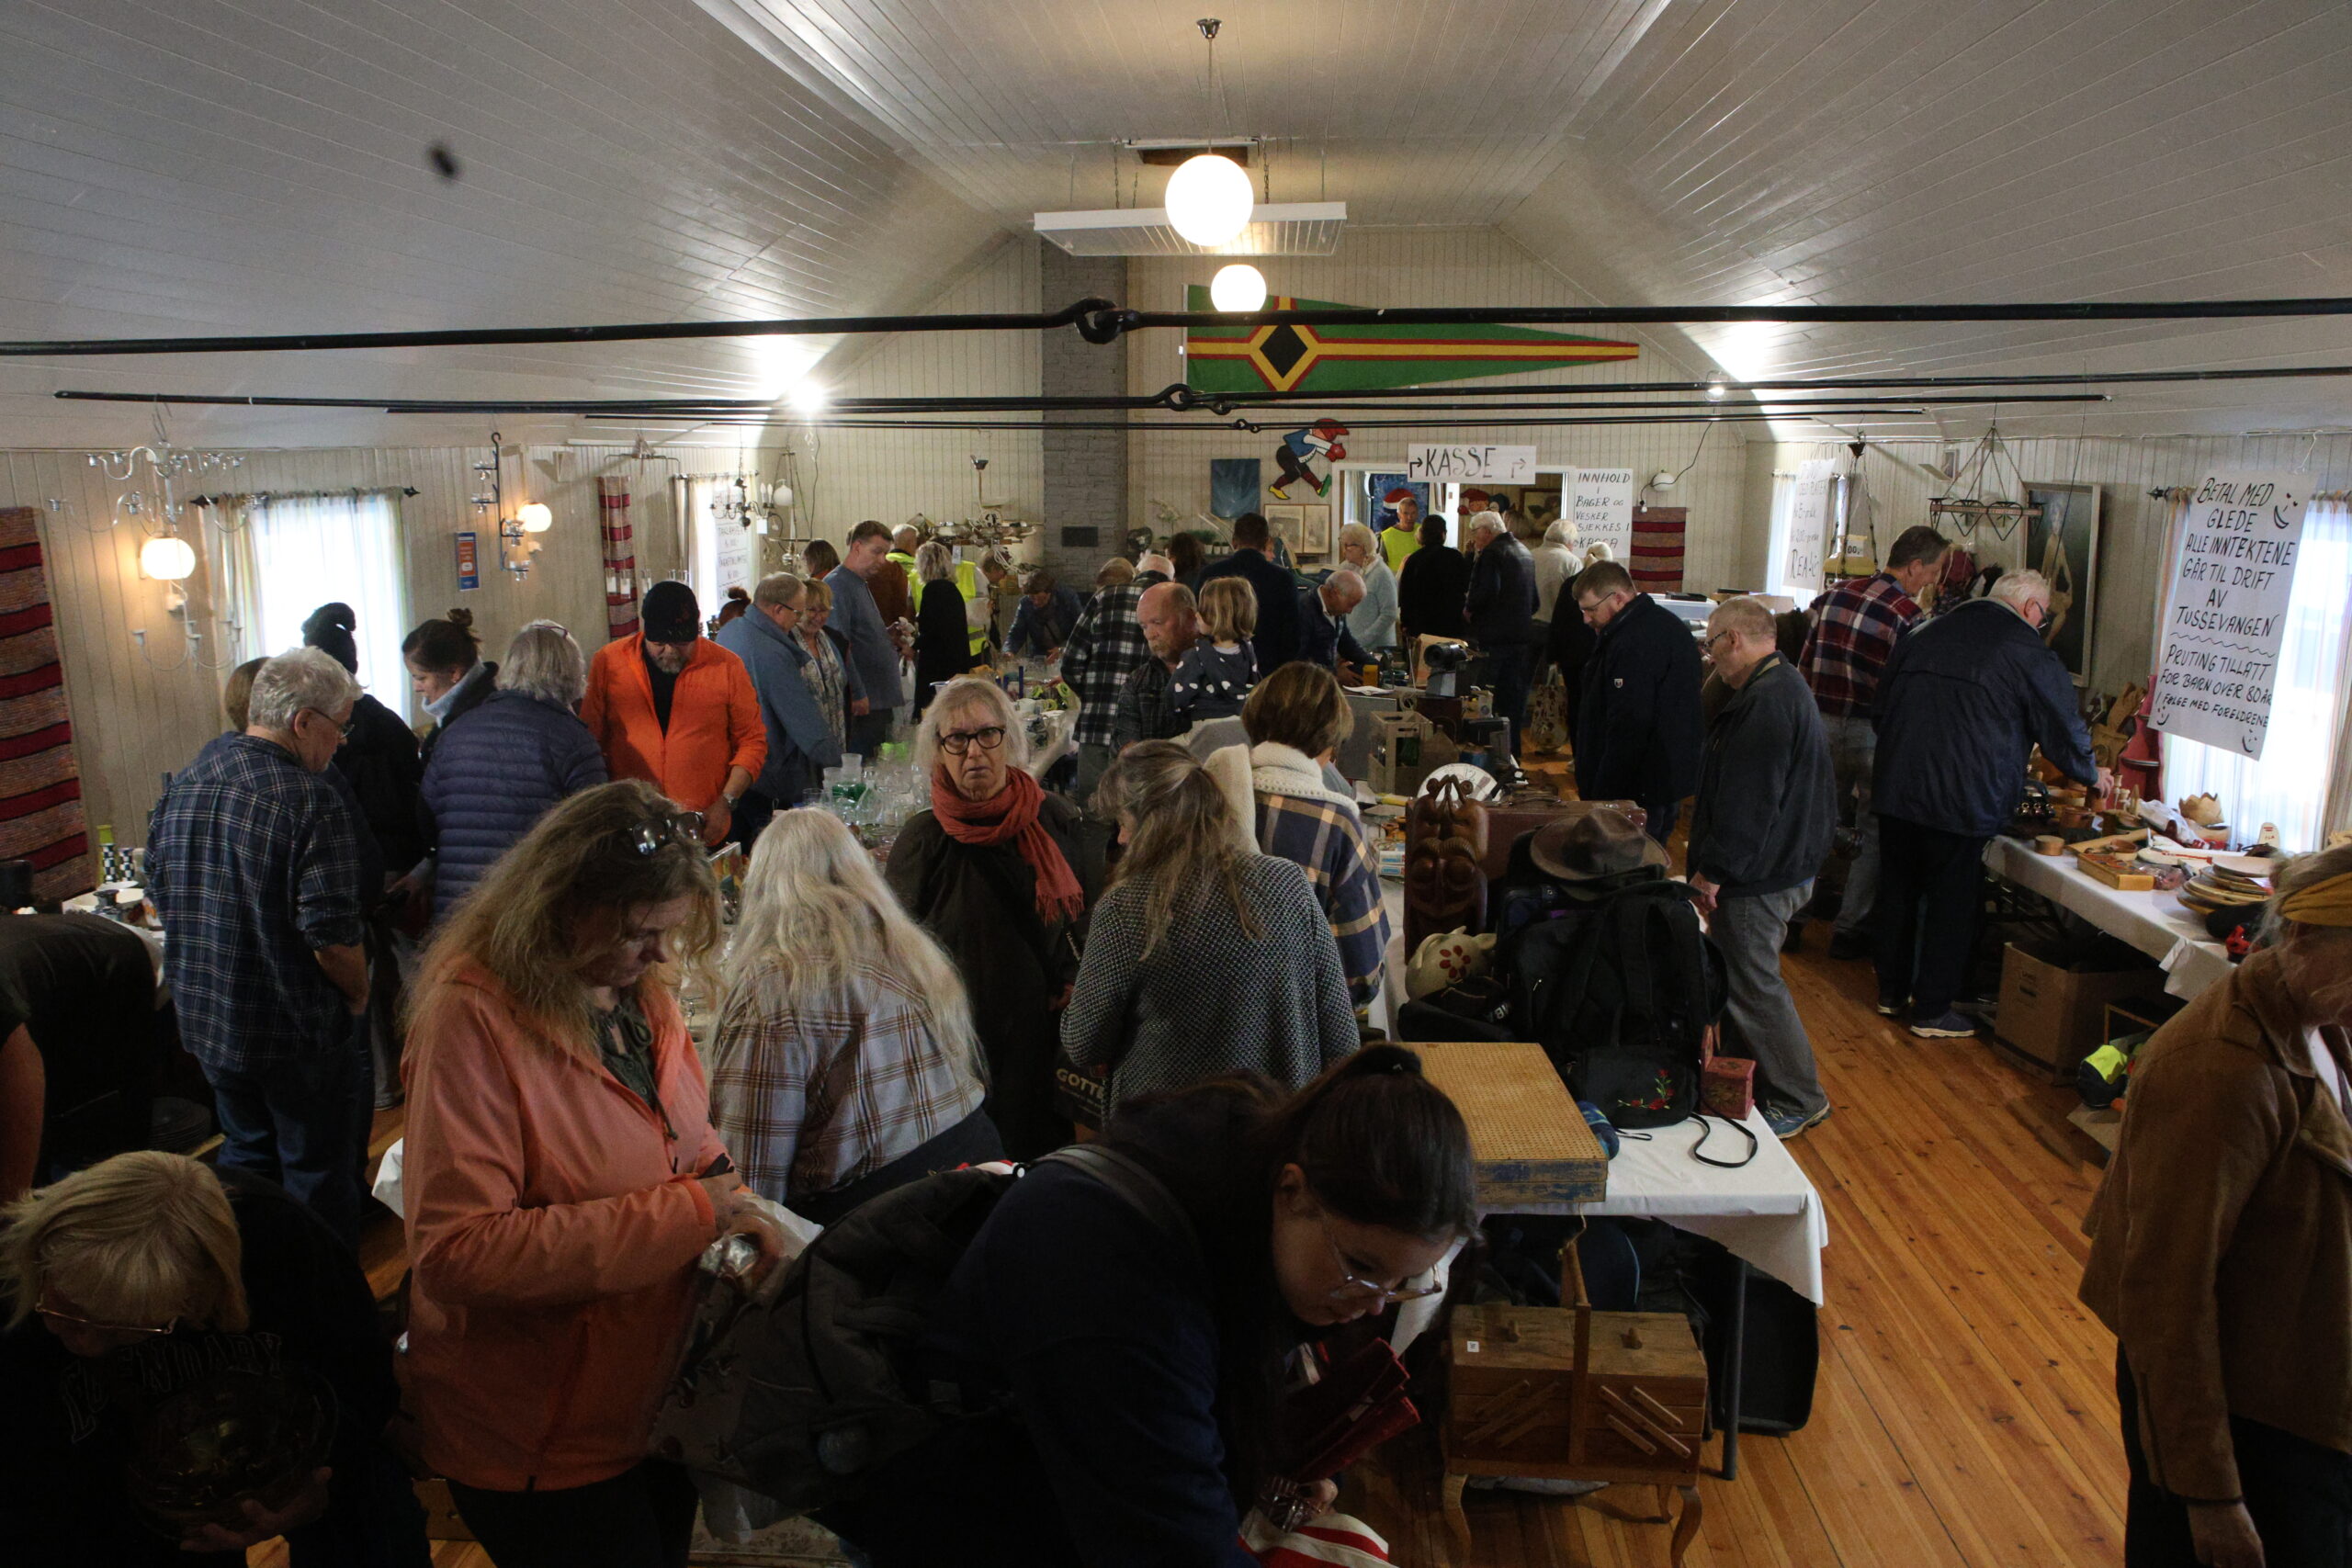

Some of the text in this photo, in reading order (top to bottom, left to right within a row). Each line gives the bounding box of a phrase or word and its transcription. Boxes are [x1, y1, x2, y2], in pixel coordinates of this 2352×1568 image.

[1426, 447, 1496, 478] KASSE
[1577, 473, 1631, 483] INNHOLD
[2197, 478, 2274, 507] BETAL MED
[1576, 495, 1610, 507] BAGER
[1576, 511, 1609, 521] VESKER
[1577, 523, 1622, 532] SJEKKES
[2207, 508, 2258, 533] GLEDE
[2186, 533, 2295, 566] ALLE INNTEKTENE
[2183, 558, 2275, 590] GÅR TIL DRIFT
[2206, 588, 2228, 608] AV
[2177, 606, 2279, 637] TUSSEVANGEN
[2165, 644, 2271, 681] PRUTING TILLATT
[2160, 669, 2272, 705] FOR BARN OVER 80 ÅR
[2188, 699, 2210, 711] MED
[2211, 704, 2269, 728] FORELDRENE
